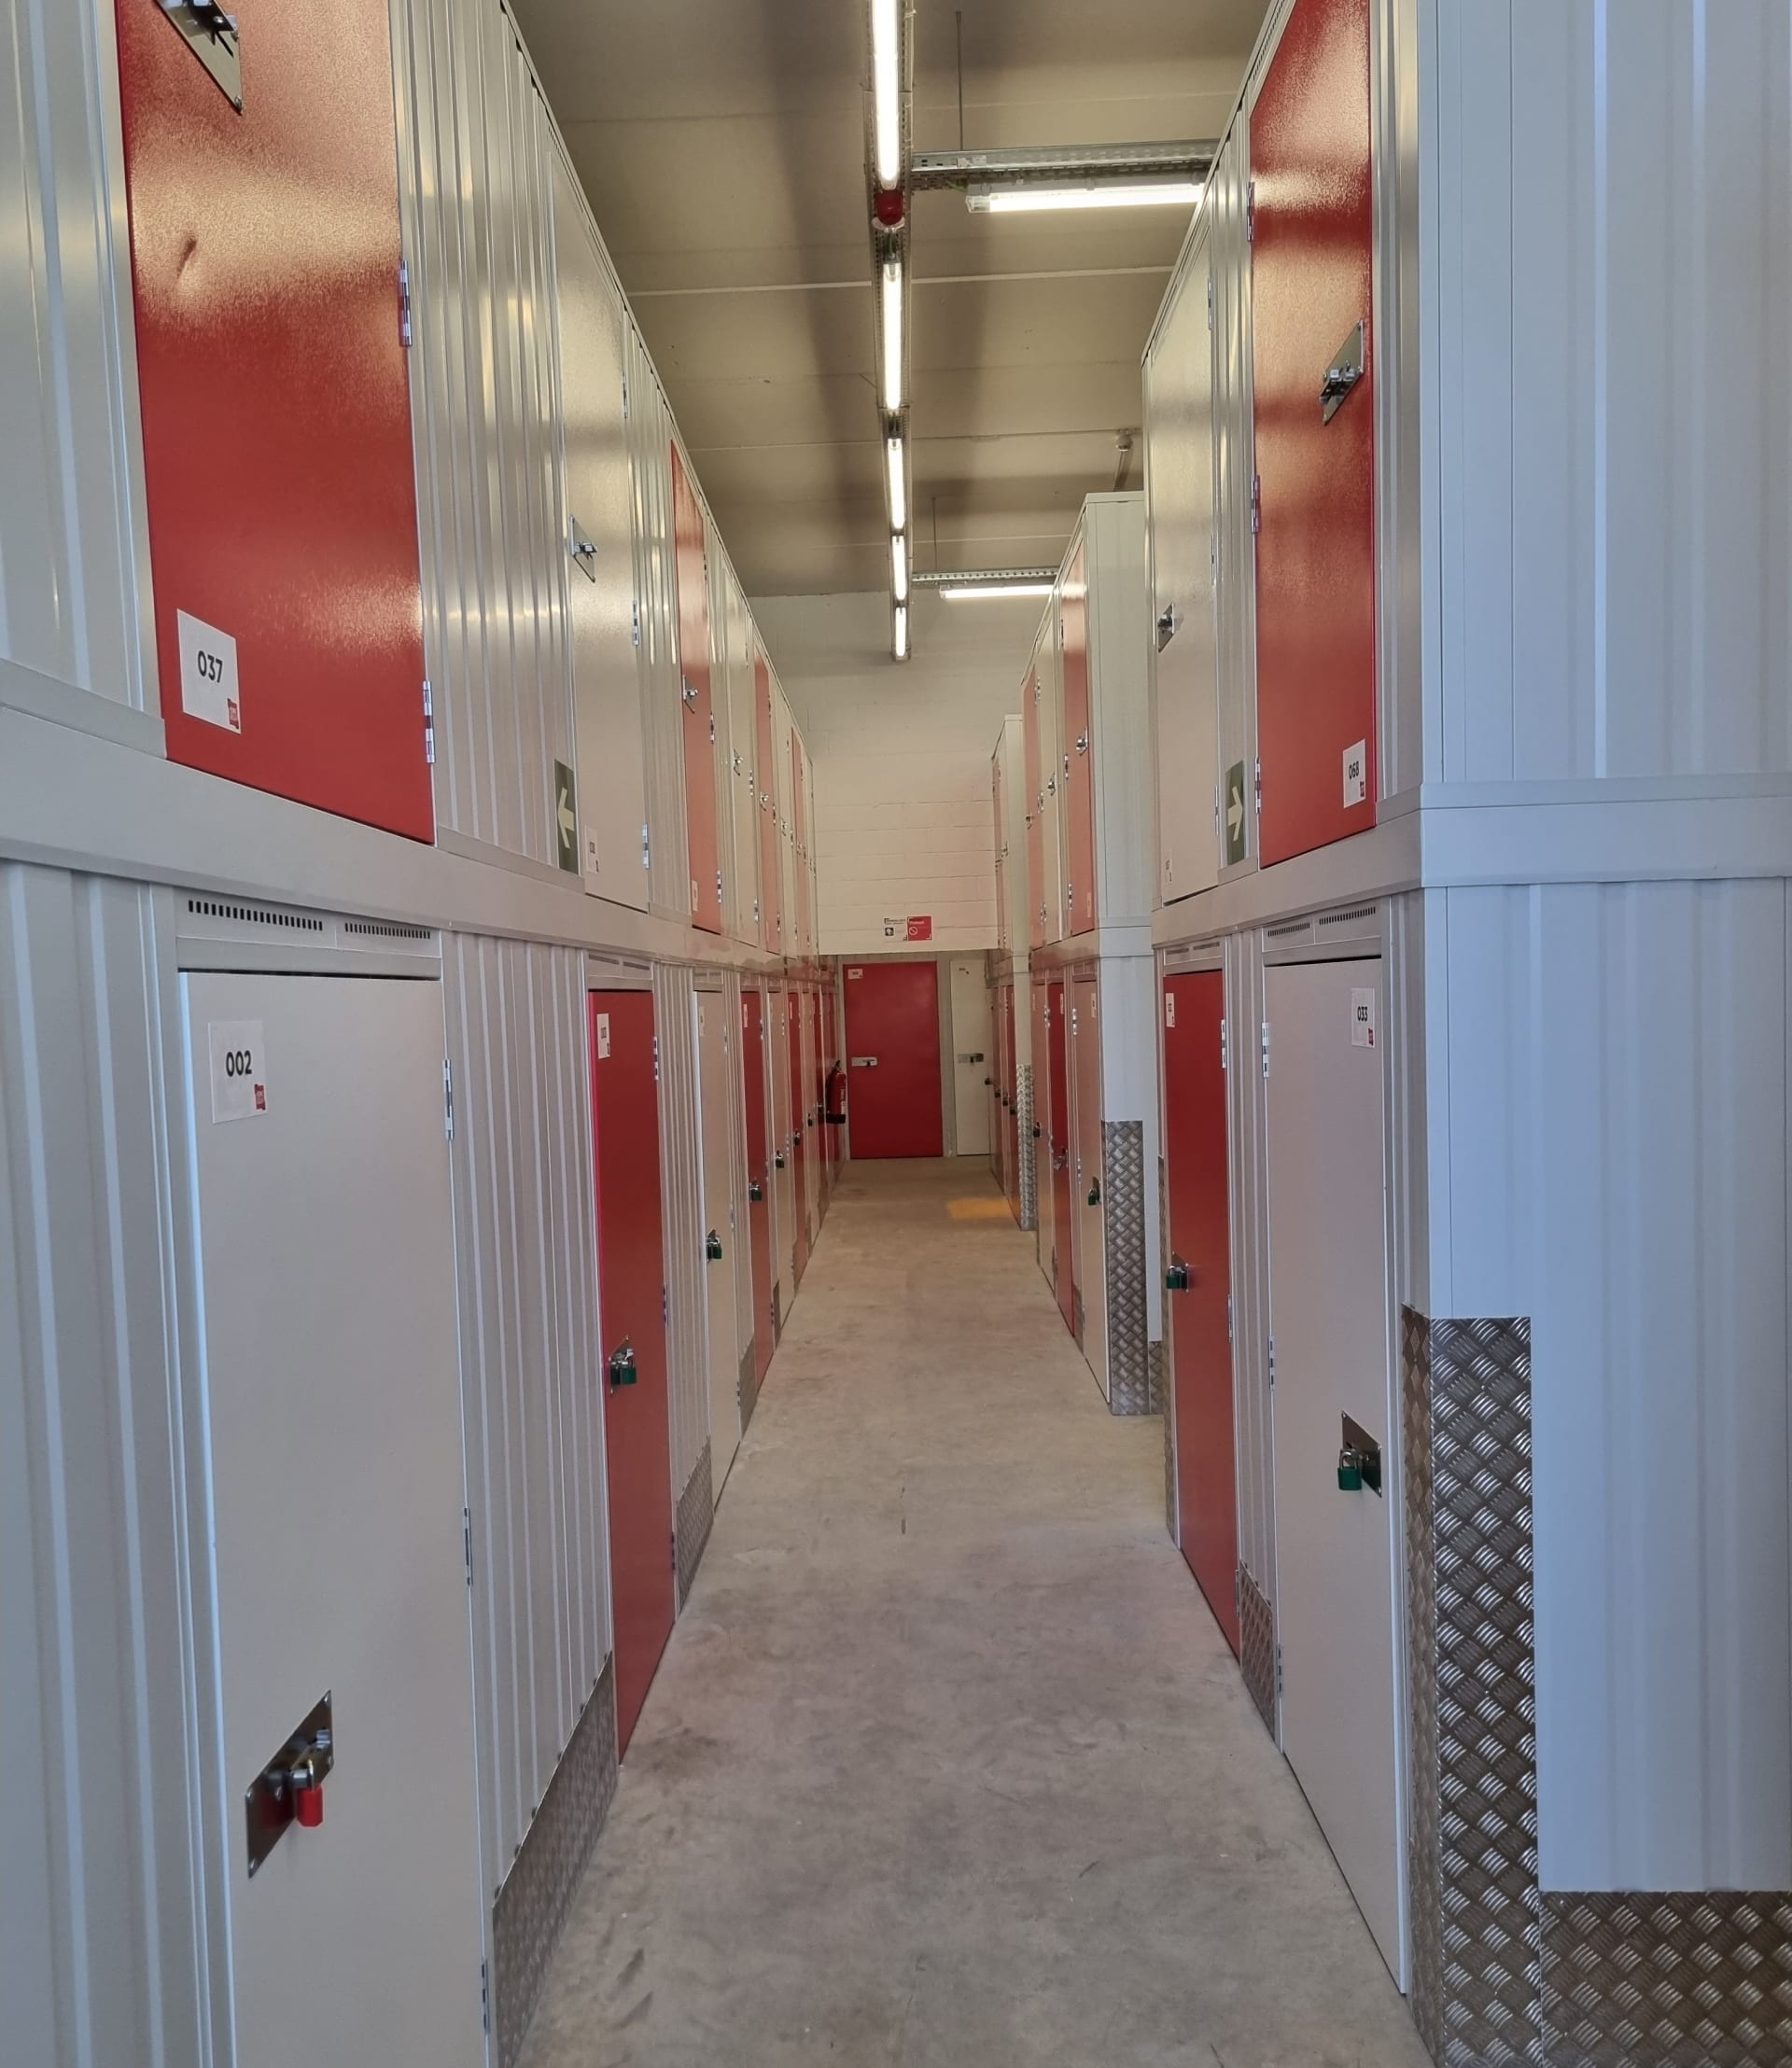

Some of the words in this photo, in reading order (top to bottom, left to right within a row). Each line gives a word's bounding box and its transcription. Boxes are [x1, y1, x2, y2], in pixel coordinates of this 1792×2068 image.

[197, 650, 223, 683] 037
[1357, 1006, 1367, 1022] 033
[226, 1050, 252, 1077] 002
